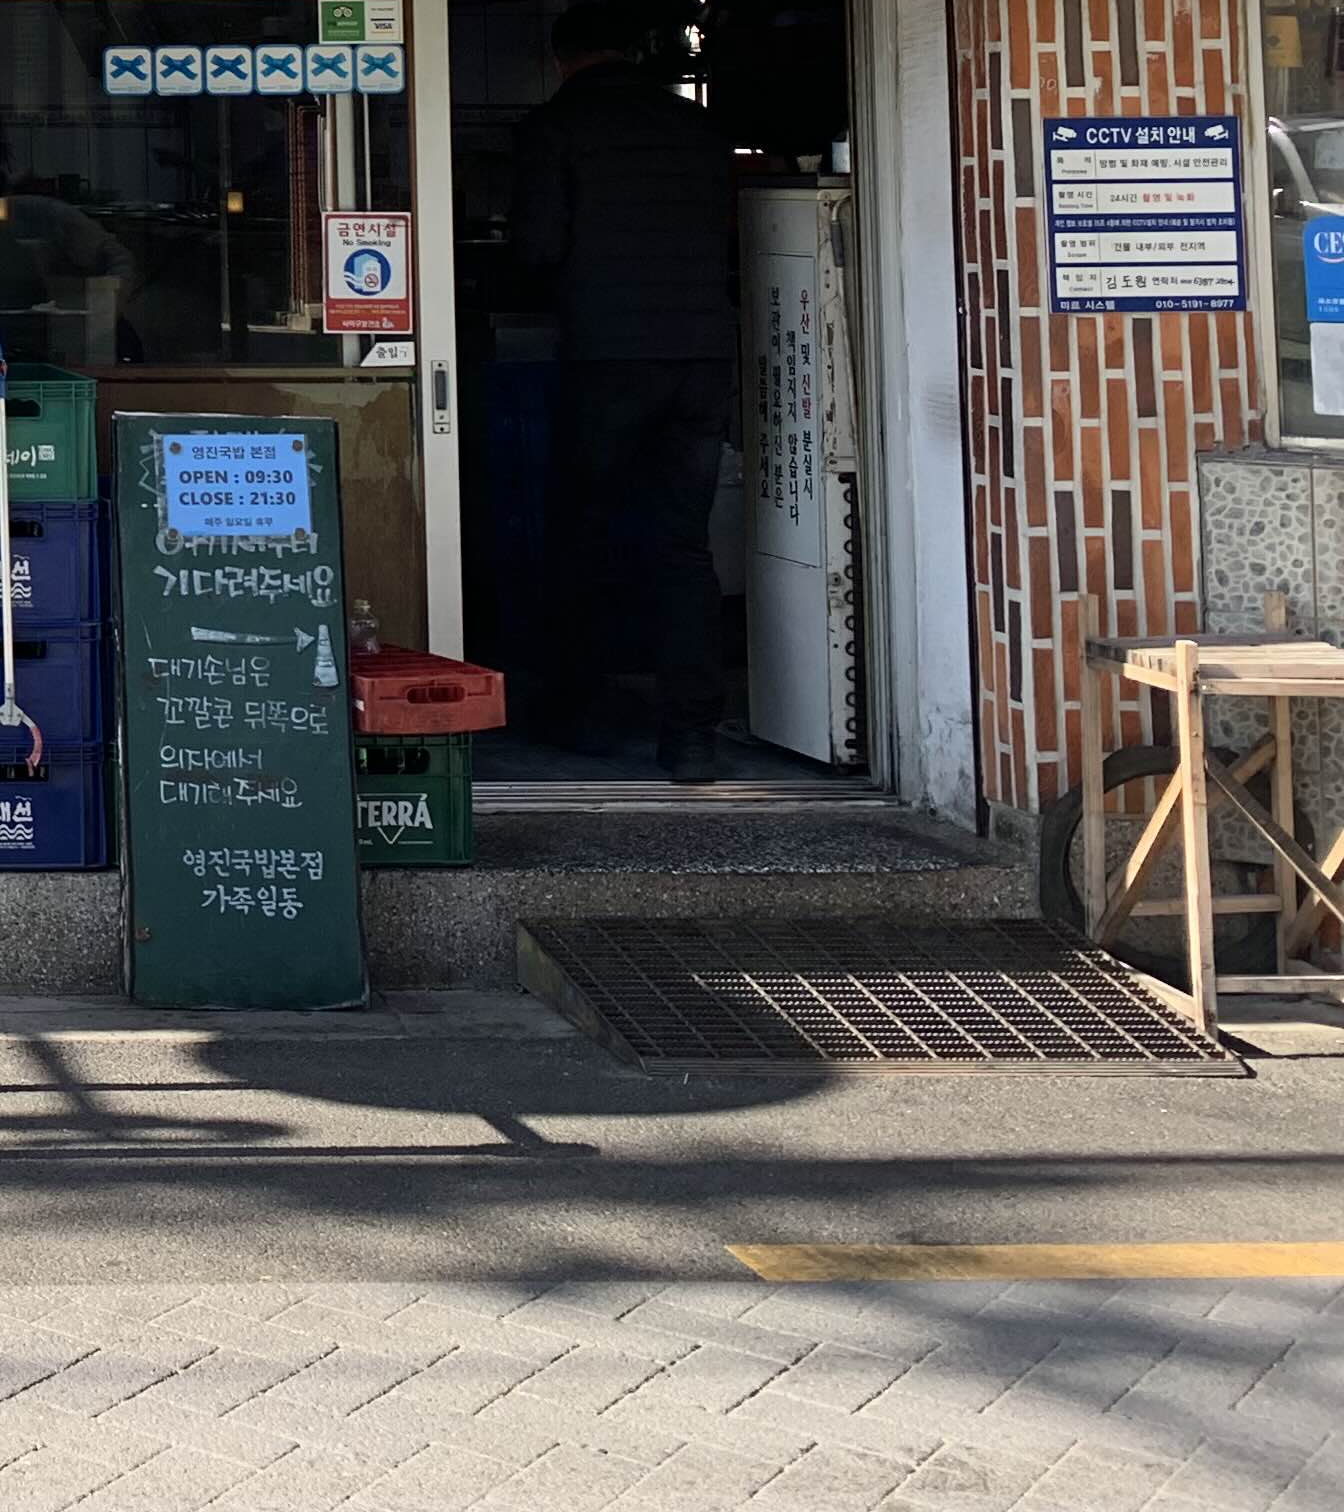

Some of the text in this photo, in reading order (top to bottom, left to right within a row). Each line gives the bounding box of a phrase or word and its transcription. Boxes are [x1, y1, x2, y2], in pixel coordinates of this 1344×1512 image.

[1086, 126, 1196, 144] CCTV 설치 안내
[336, 222, 397, 238] 금연시설
[356, 239, 392, 248] Smoking
[1313, 231, 1344, 254] CE
[799, 289, 811, 335] 우산
[1085, 300, 1116, 311] 시스템
[801, 344, 811, 366] 및
[801, 374, 812, 419] 신발
[192, 446, 277, 460] 영진국밥 본점
[179, 470, 229, 484] OPEN
[244, 469, 293, 484] 09:30
[788, 433, 800, 526] 않습니다
[179, 491, 234, 506] CLOSE
[250, 491, 296, 506] 21:30
[226, 517, 253, 527] 일요일
[153, 565, 338, 607] 기다려주세요
[148, 654, 271, 687] 대기손님은
[156, 696, 329, 735] 꼬깔콘 뒤쪽으로
[160, 745, 263, 771] 의자에서
[201, 884, 304, 919] 가족일동
